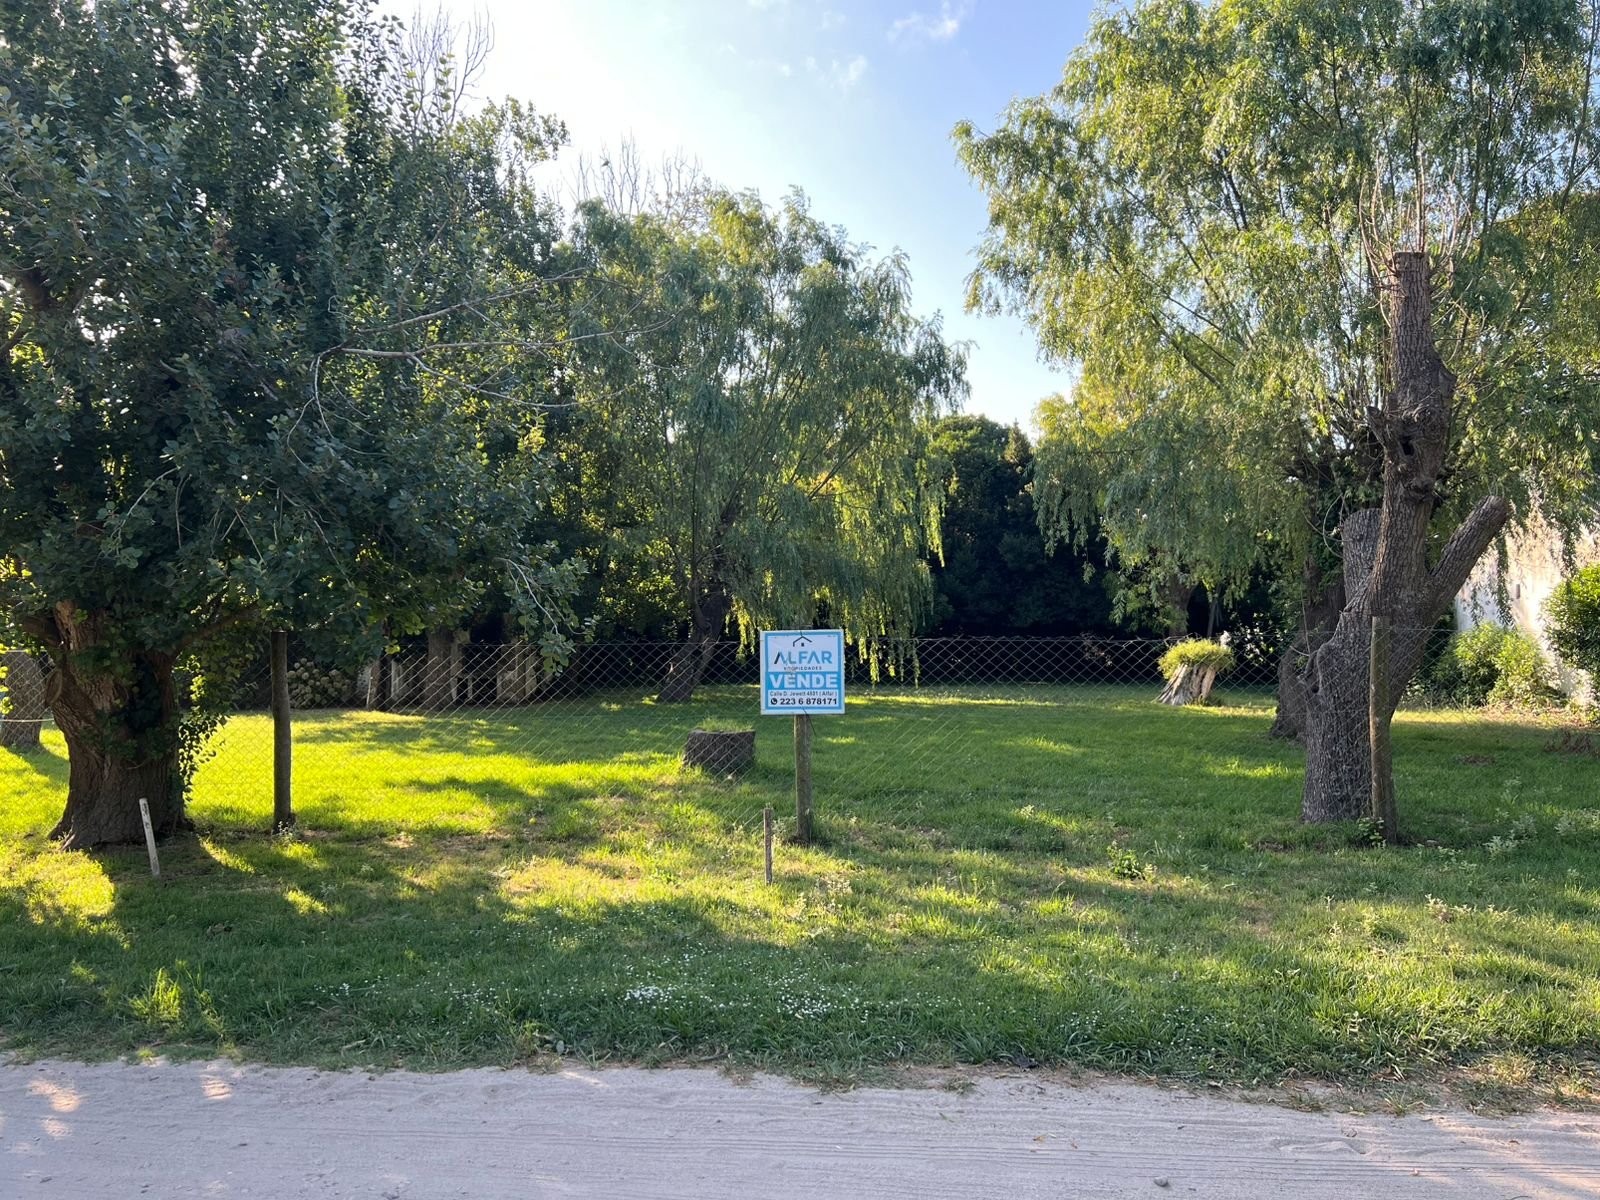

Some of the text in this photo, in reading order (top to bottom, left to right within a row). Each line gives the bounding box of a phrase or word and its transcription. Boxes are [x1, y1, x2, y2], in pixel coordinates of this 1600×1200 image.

[774, 650, 833, 665] ALFAR
[769, 673, 839, 689] VENDE
[780, 697, 837, 705] 223 6 878171
